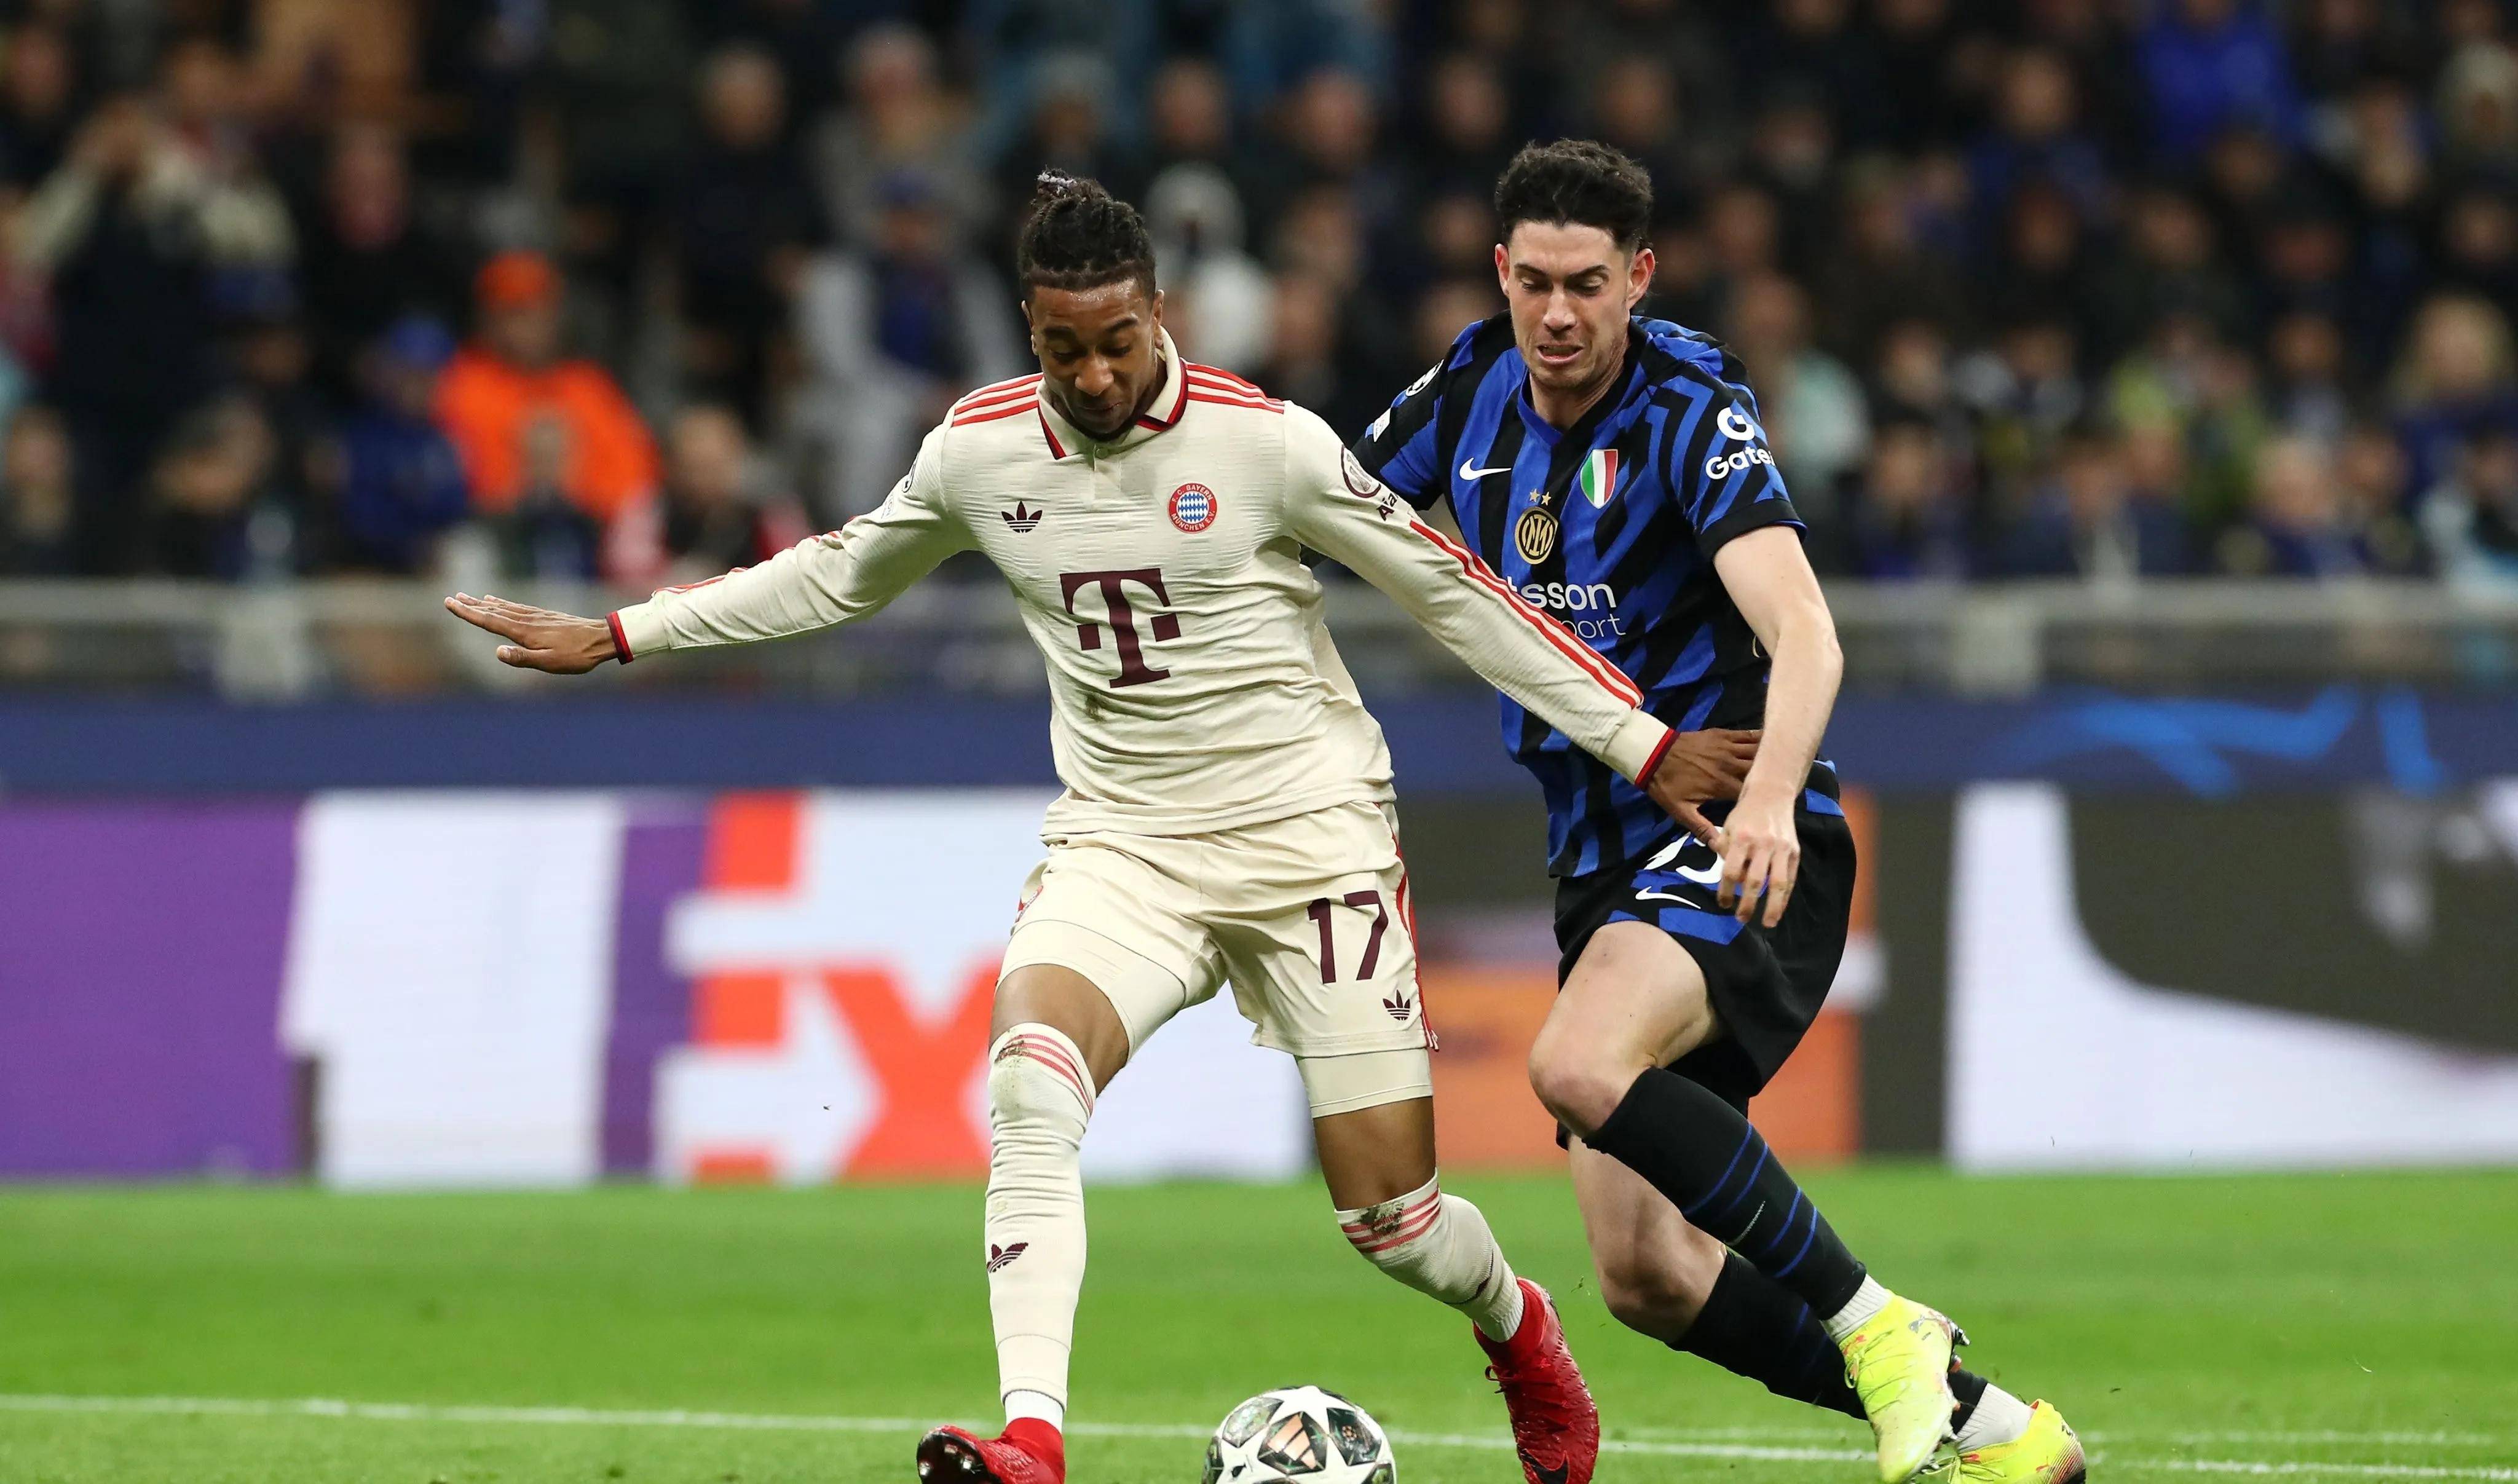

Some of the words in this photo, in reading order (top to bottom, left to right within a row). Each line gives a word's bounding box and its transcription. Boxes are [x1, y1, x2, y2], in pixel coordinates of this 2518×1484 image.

[1186, 484, 1214, 500] BAYERN
[1059, 567, 1181, 689] T
[1306, 890, 1389, 984] 17
